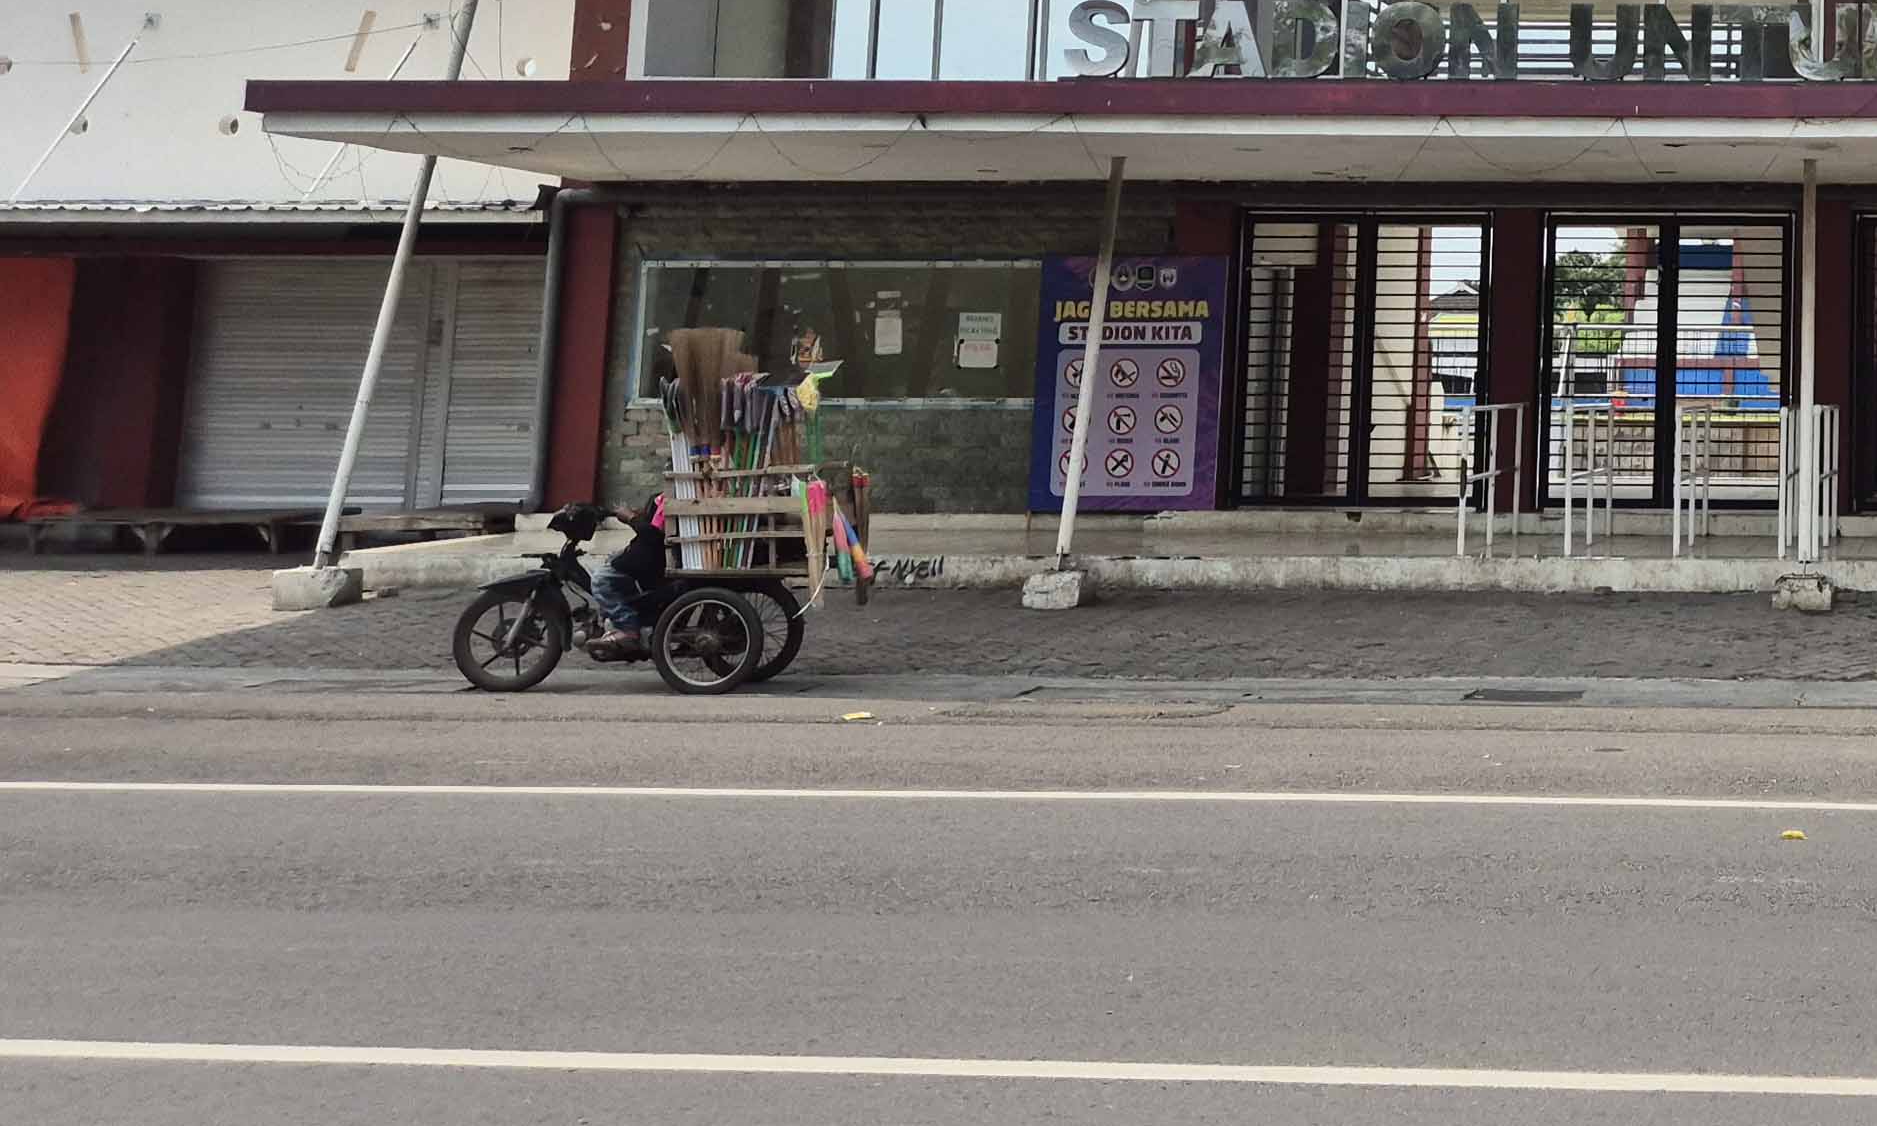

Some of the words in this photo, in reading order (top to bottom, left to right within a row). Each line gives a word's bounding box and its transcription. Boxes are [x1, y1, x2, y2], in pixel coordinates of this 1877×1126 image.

[1054, 300, 1099, 322] JAG
[1110, 300, 1209, 319] BERSAMA
[1068, 325, 1146, 341] STDION
[1151, 325, 1193, 341] KITA
